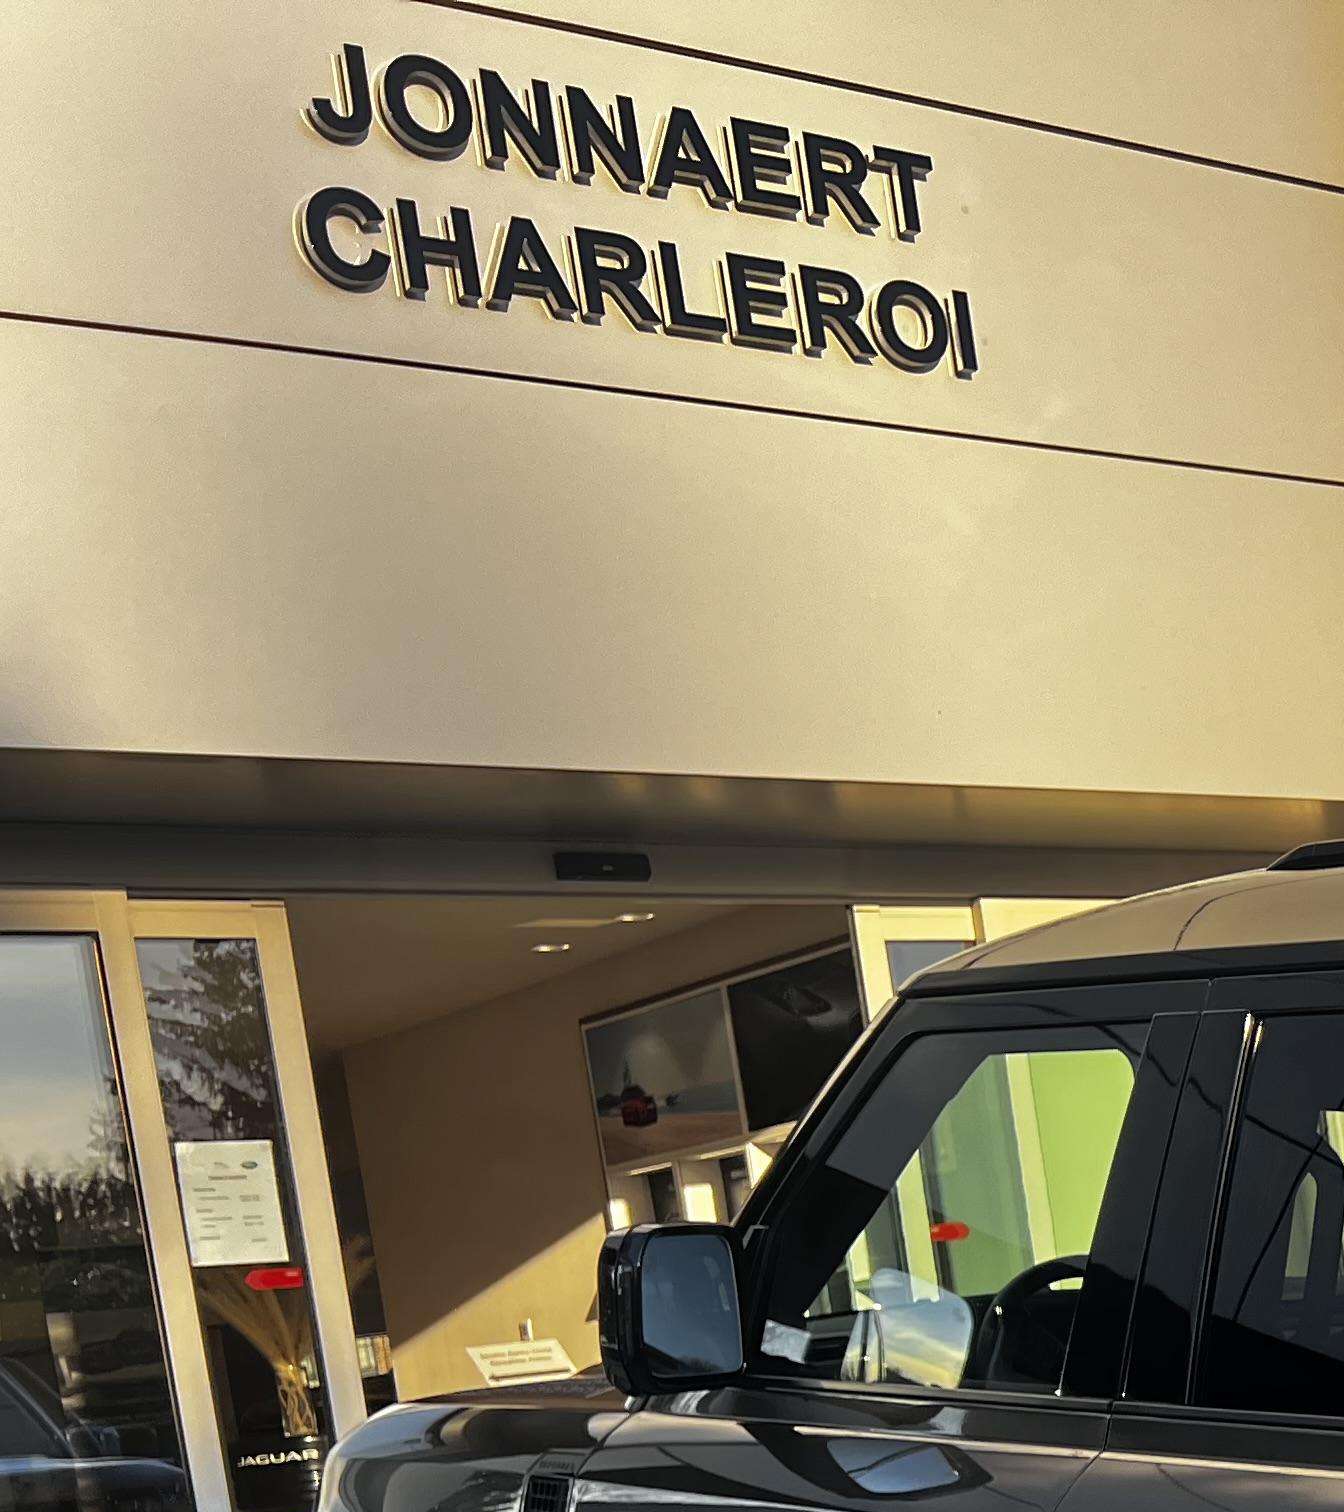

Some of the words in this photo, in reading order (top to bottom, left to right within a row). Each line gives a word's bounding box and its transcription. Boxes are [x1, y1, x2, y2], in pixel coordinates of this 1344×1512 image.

[302, 43, 933, 242] JONNAERT
[296, 186, 980, 381] CHARLEROI
[237, 1448, 319, 1468] JAGUAR
